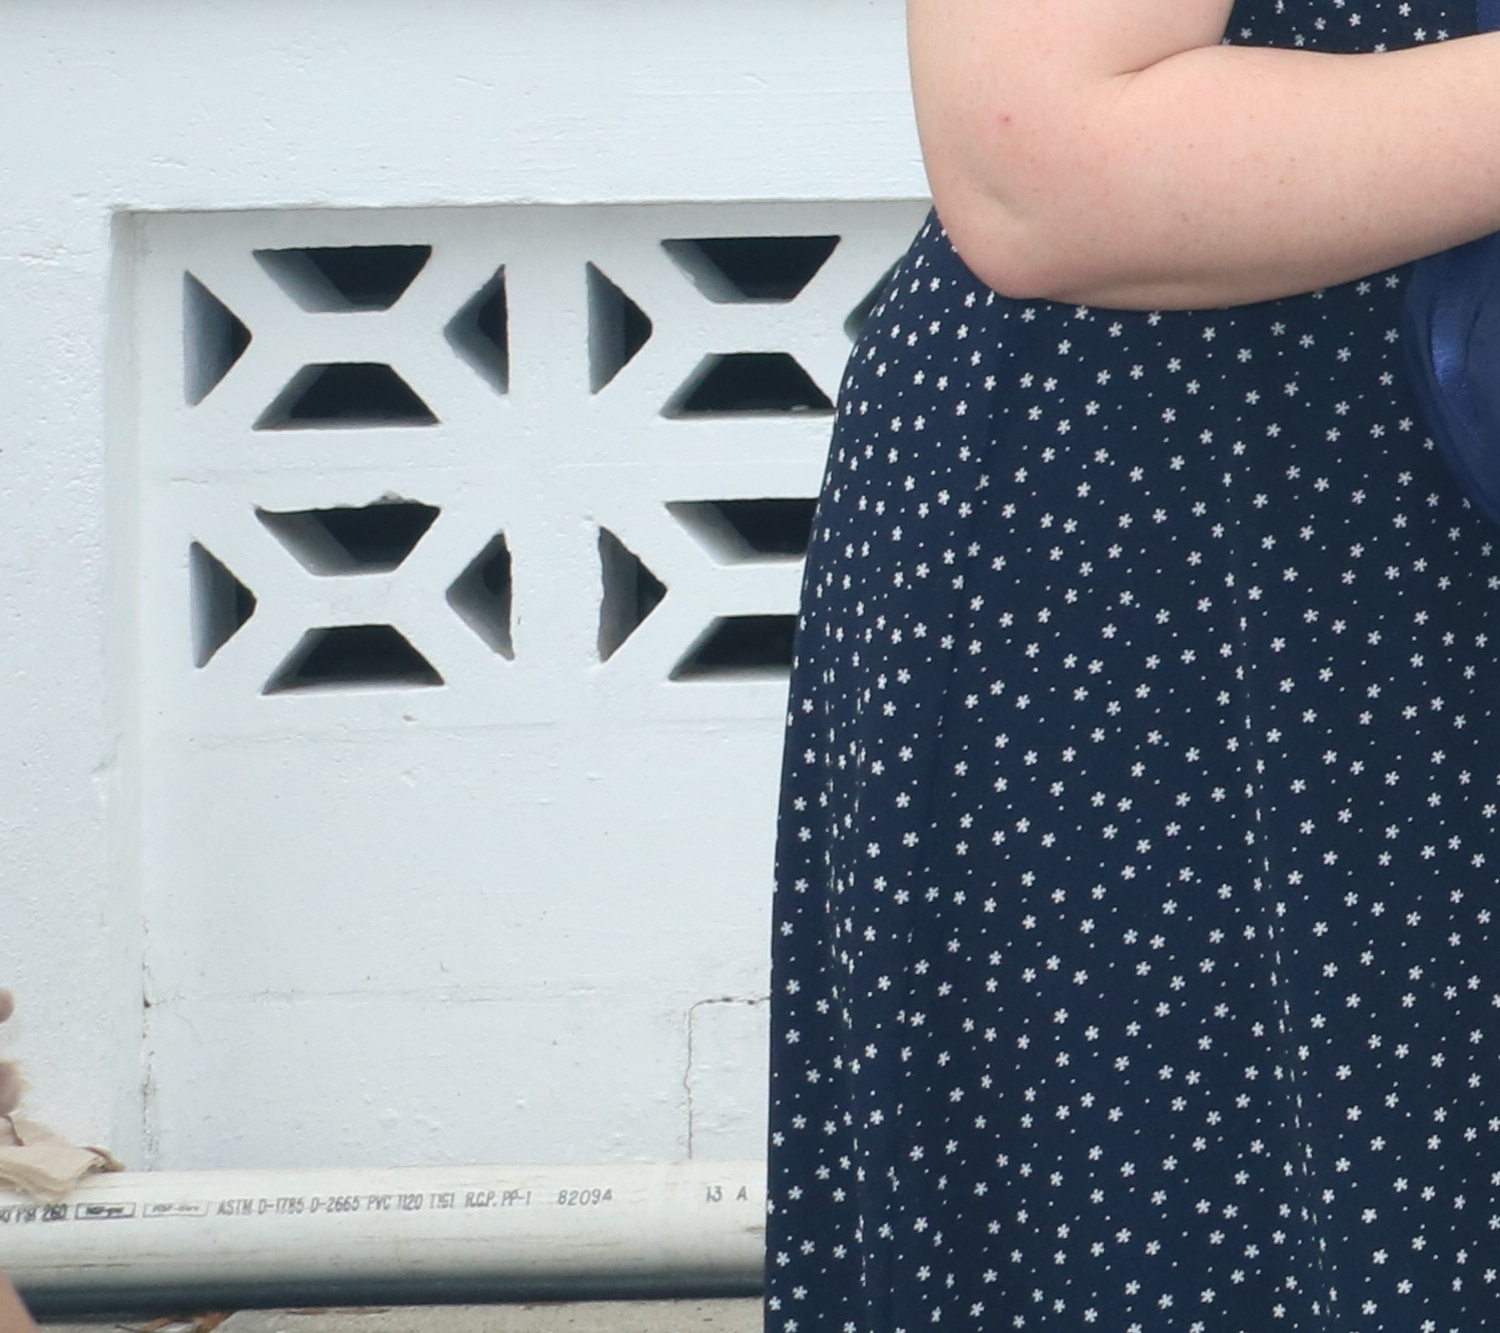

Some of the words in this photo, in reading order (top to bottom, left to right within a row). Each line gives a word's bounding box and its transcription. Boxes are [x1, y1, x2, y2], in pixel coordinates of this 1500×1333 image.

[215, 1198, 254, 1216] ASTM
[257, 1196, 305, 1215] D-1785
[309, 1195, 361, 1213] D-2665
[366, 1194, 392, 1211] PVC
[397, 1193, 424, 1211] 1120
[705, 1185, 723, 1202] 13
[735, 1185, 749, 1202] A
